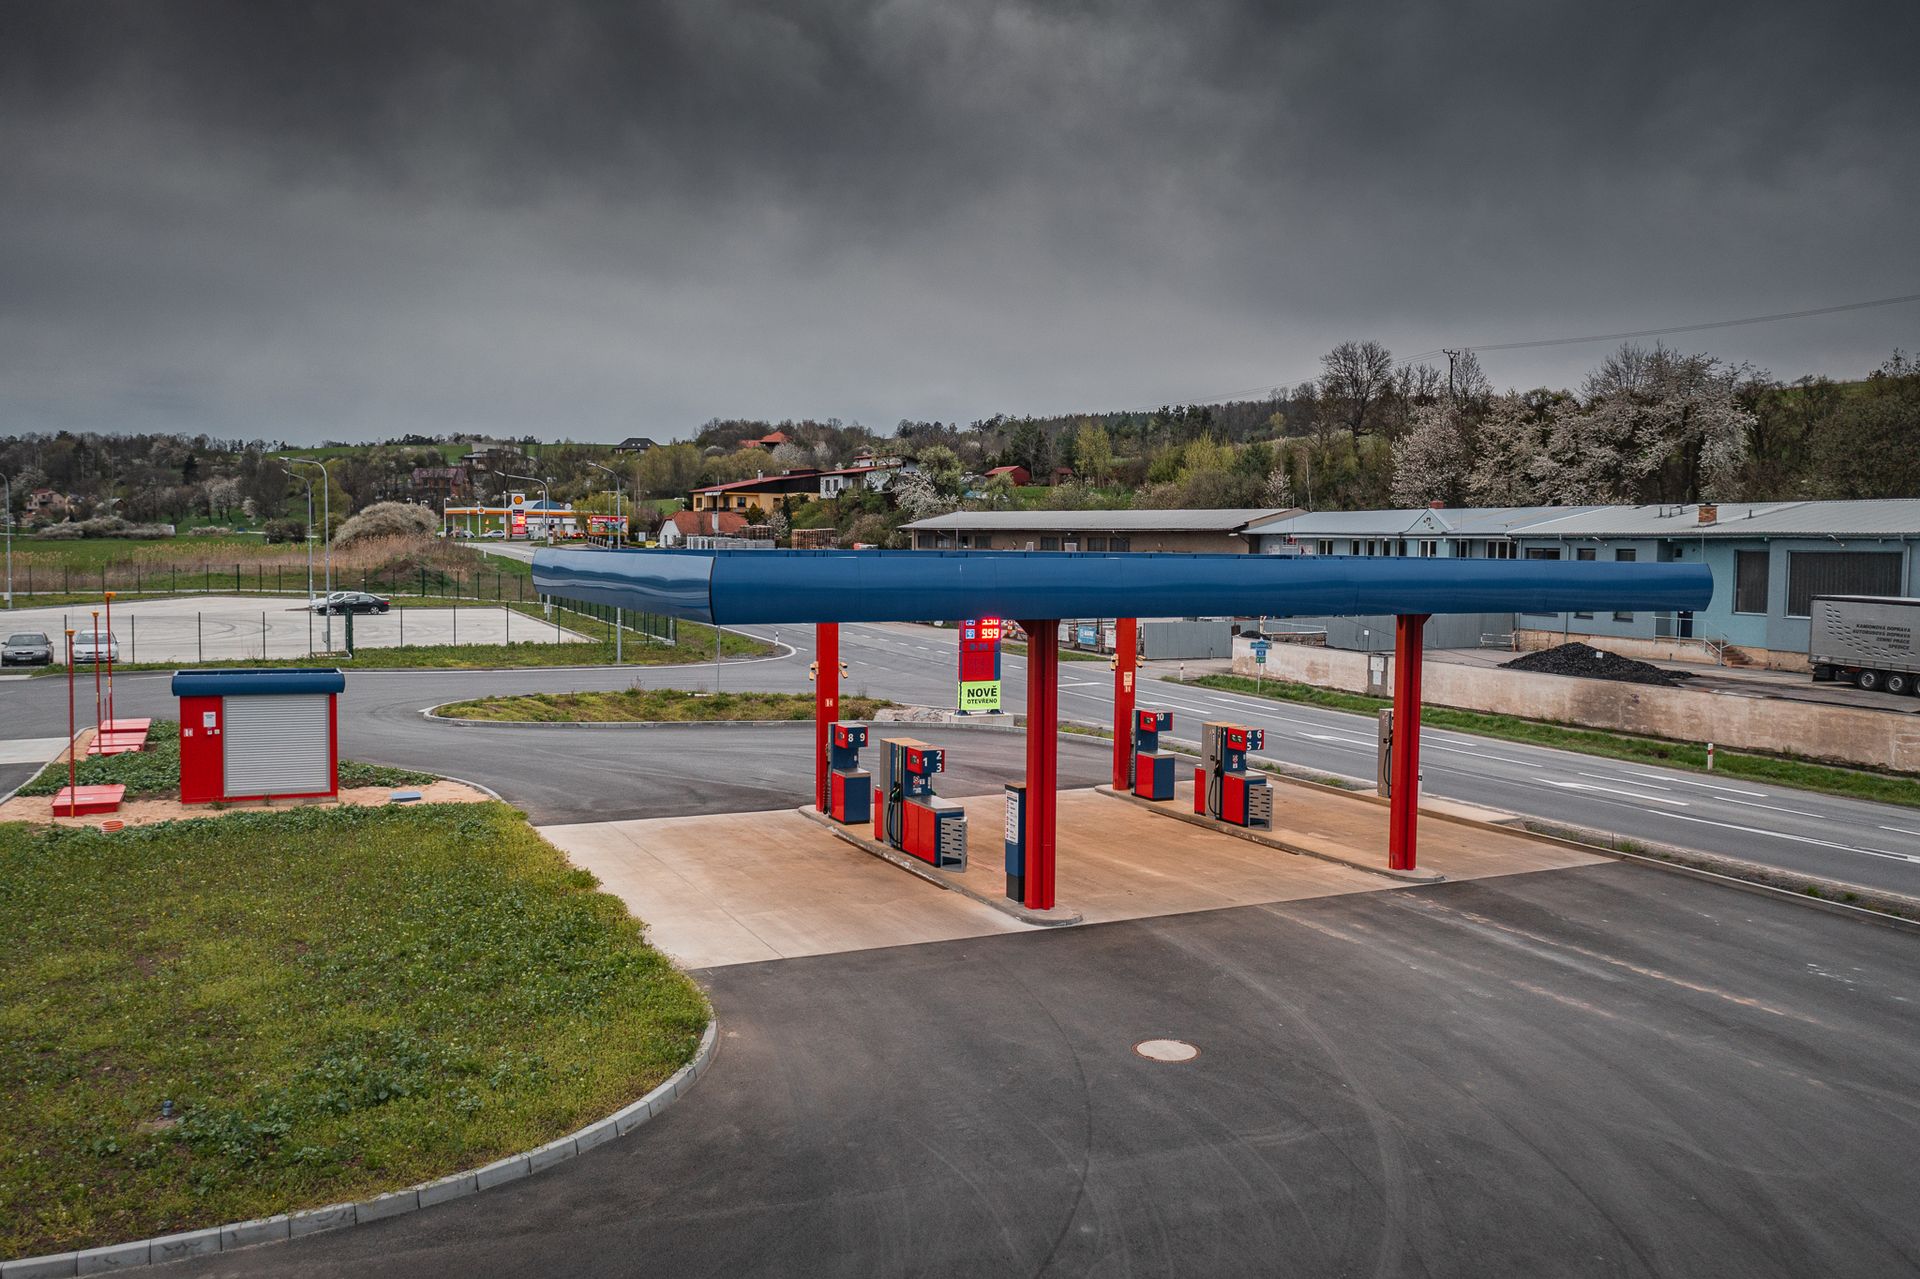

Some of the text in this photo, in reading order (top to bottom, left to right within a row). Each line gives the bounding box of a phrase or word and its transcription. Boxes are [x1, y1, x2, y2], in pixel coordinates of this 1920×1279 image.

[1156, 713, 1165, 721] 10
[848, 732, 866, 742] 8 9
[1246, 730, 1262, 739] 4 6
[1246, 741, 1262, 751] 5 7
[936, 750, 942, 760] 2
[922, 757, 928, 767] 1
[936, 763, 942, 773] 3
